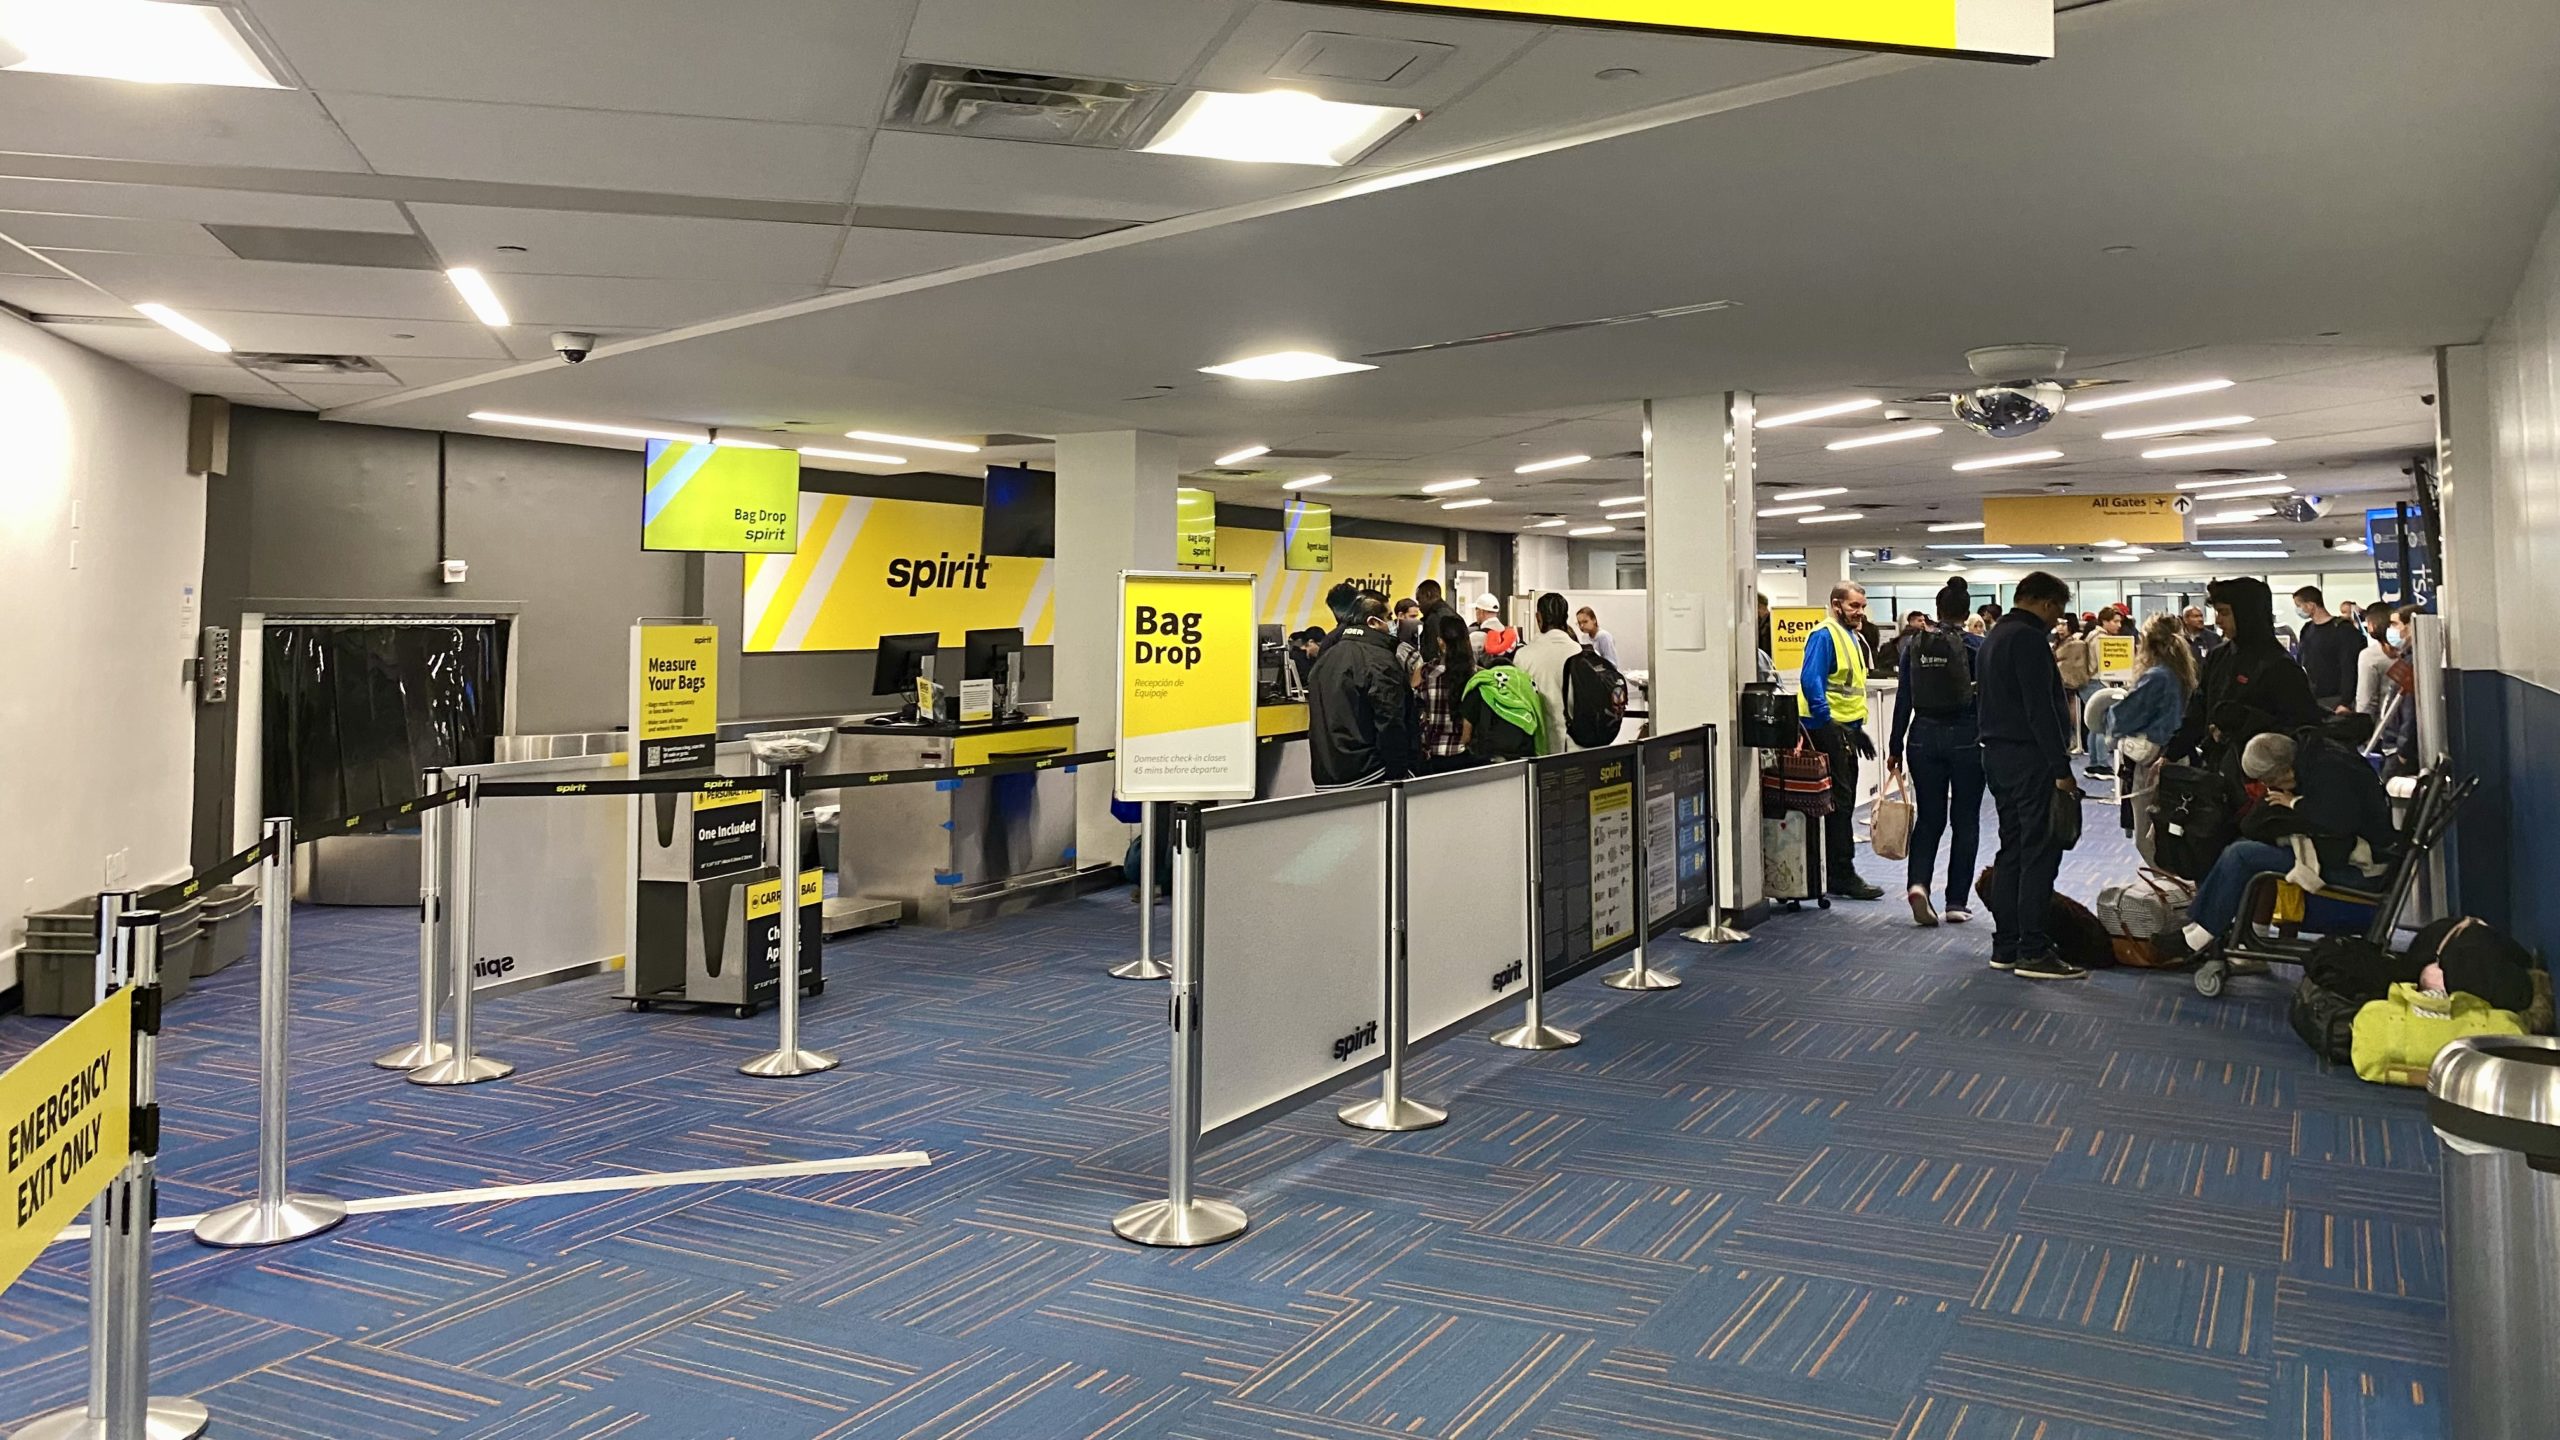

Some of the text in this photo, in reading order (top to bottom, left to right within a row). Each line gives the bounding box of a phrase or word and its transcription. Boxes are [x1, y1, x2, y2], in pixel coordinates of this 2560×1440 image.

[2092, 497, 2147, 508] All Gates
[734, 508, 787, 524] Bag Drop
[744, 528, 786, 543] spirit
[1192, 547, 1211, 557] spirit
[2377, 560, 2399, 570] Enter
[886, 551, 990, 597] spirit
[2379, 570, 2398, 580] Here
[1135, 605, 1203, 645] Bag
[693, 636, 713, 645] spirit
[1135, 640, 1202, 670] Drop
[648, 657, 697, 673] Measure
[648, 674, 706, 693] Your Bags
[1134, 677, 1185, 689] Recepción de
[1134, 688, 1169, 699] Equipaje
[1133, 754, 1227, 763] Domestic check-in closes
[957, 767, 976, 776] spirit
[1133, 765, 1229, 775] 45 mins before departure
[1600, 761, 1623, 783] spirit
[703, 779, 735, 789] spirit
[868, 773, 889, 783] spirit
[555, 783, 588, 794] spirit
[698, 818, 757, 841] One Included
[801, 881, 817, 896] BAG
[1491, 958, 1523, 993] spirit
[1333, 1019, 1379, 1062] spirit
[8, 1049, 112, 1174] EMERGENCY
[17, 1112, 102, 1229] EXIT ONLY
